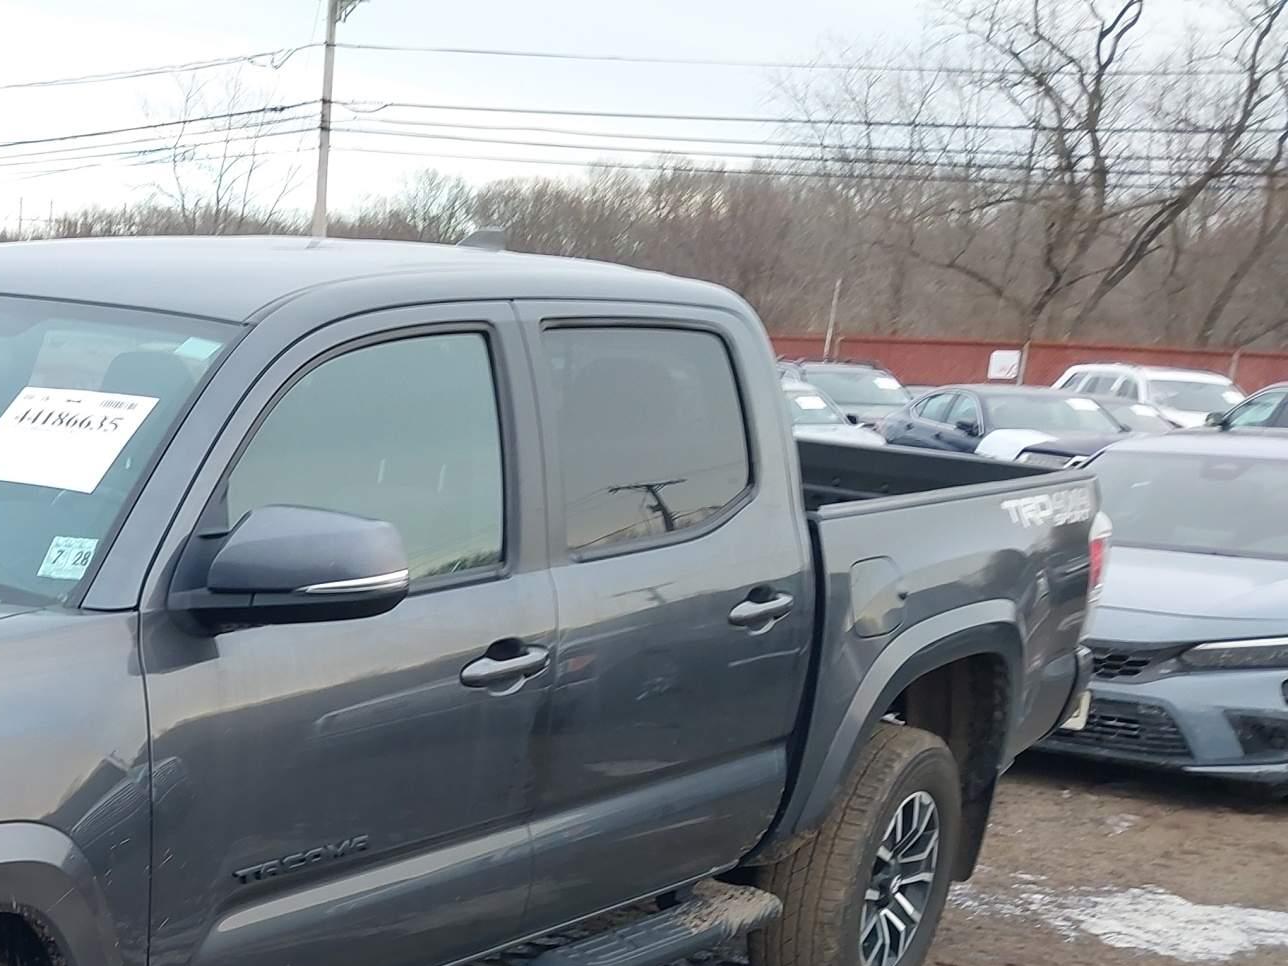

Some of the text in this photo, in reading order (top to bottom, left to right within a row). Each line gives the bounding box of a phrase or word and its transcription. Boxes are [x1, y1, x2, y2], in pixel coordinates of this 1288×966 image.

[14, 407, 125, 433] 44186635
[1000, 494, 1054, 529] TRD
[52, 549, 92, 567] 7 28
[231, 833, 370, 885] TACOMA
